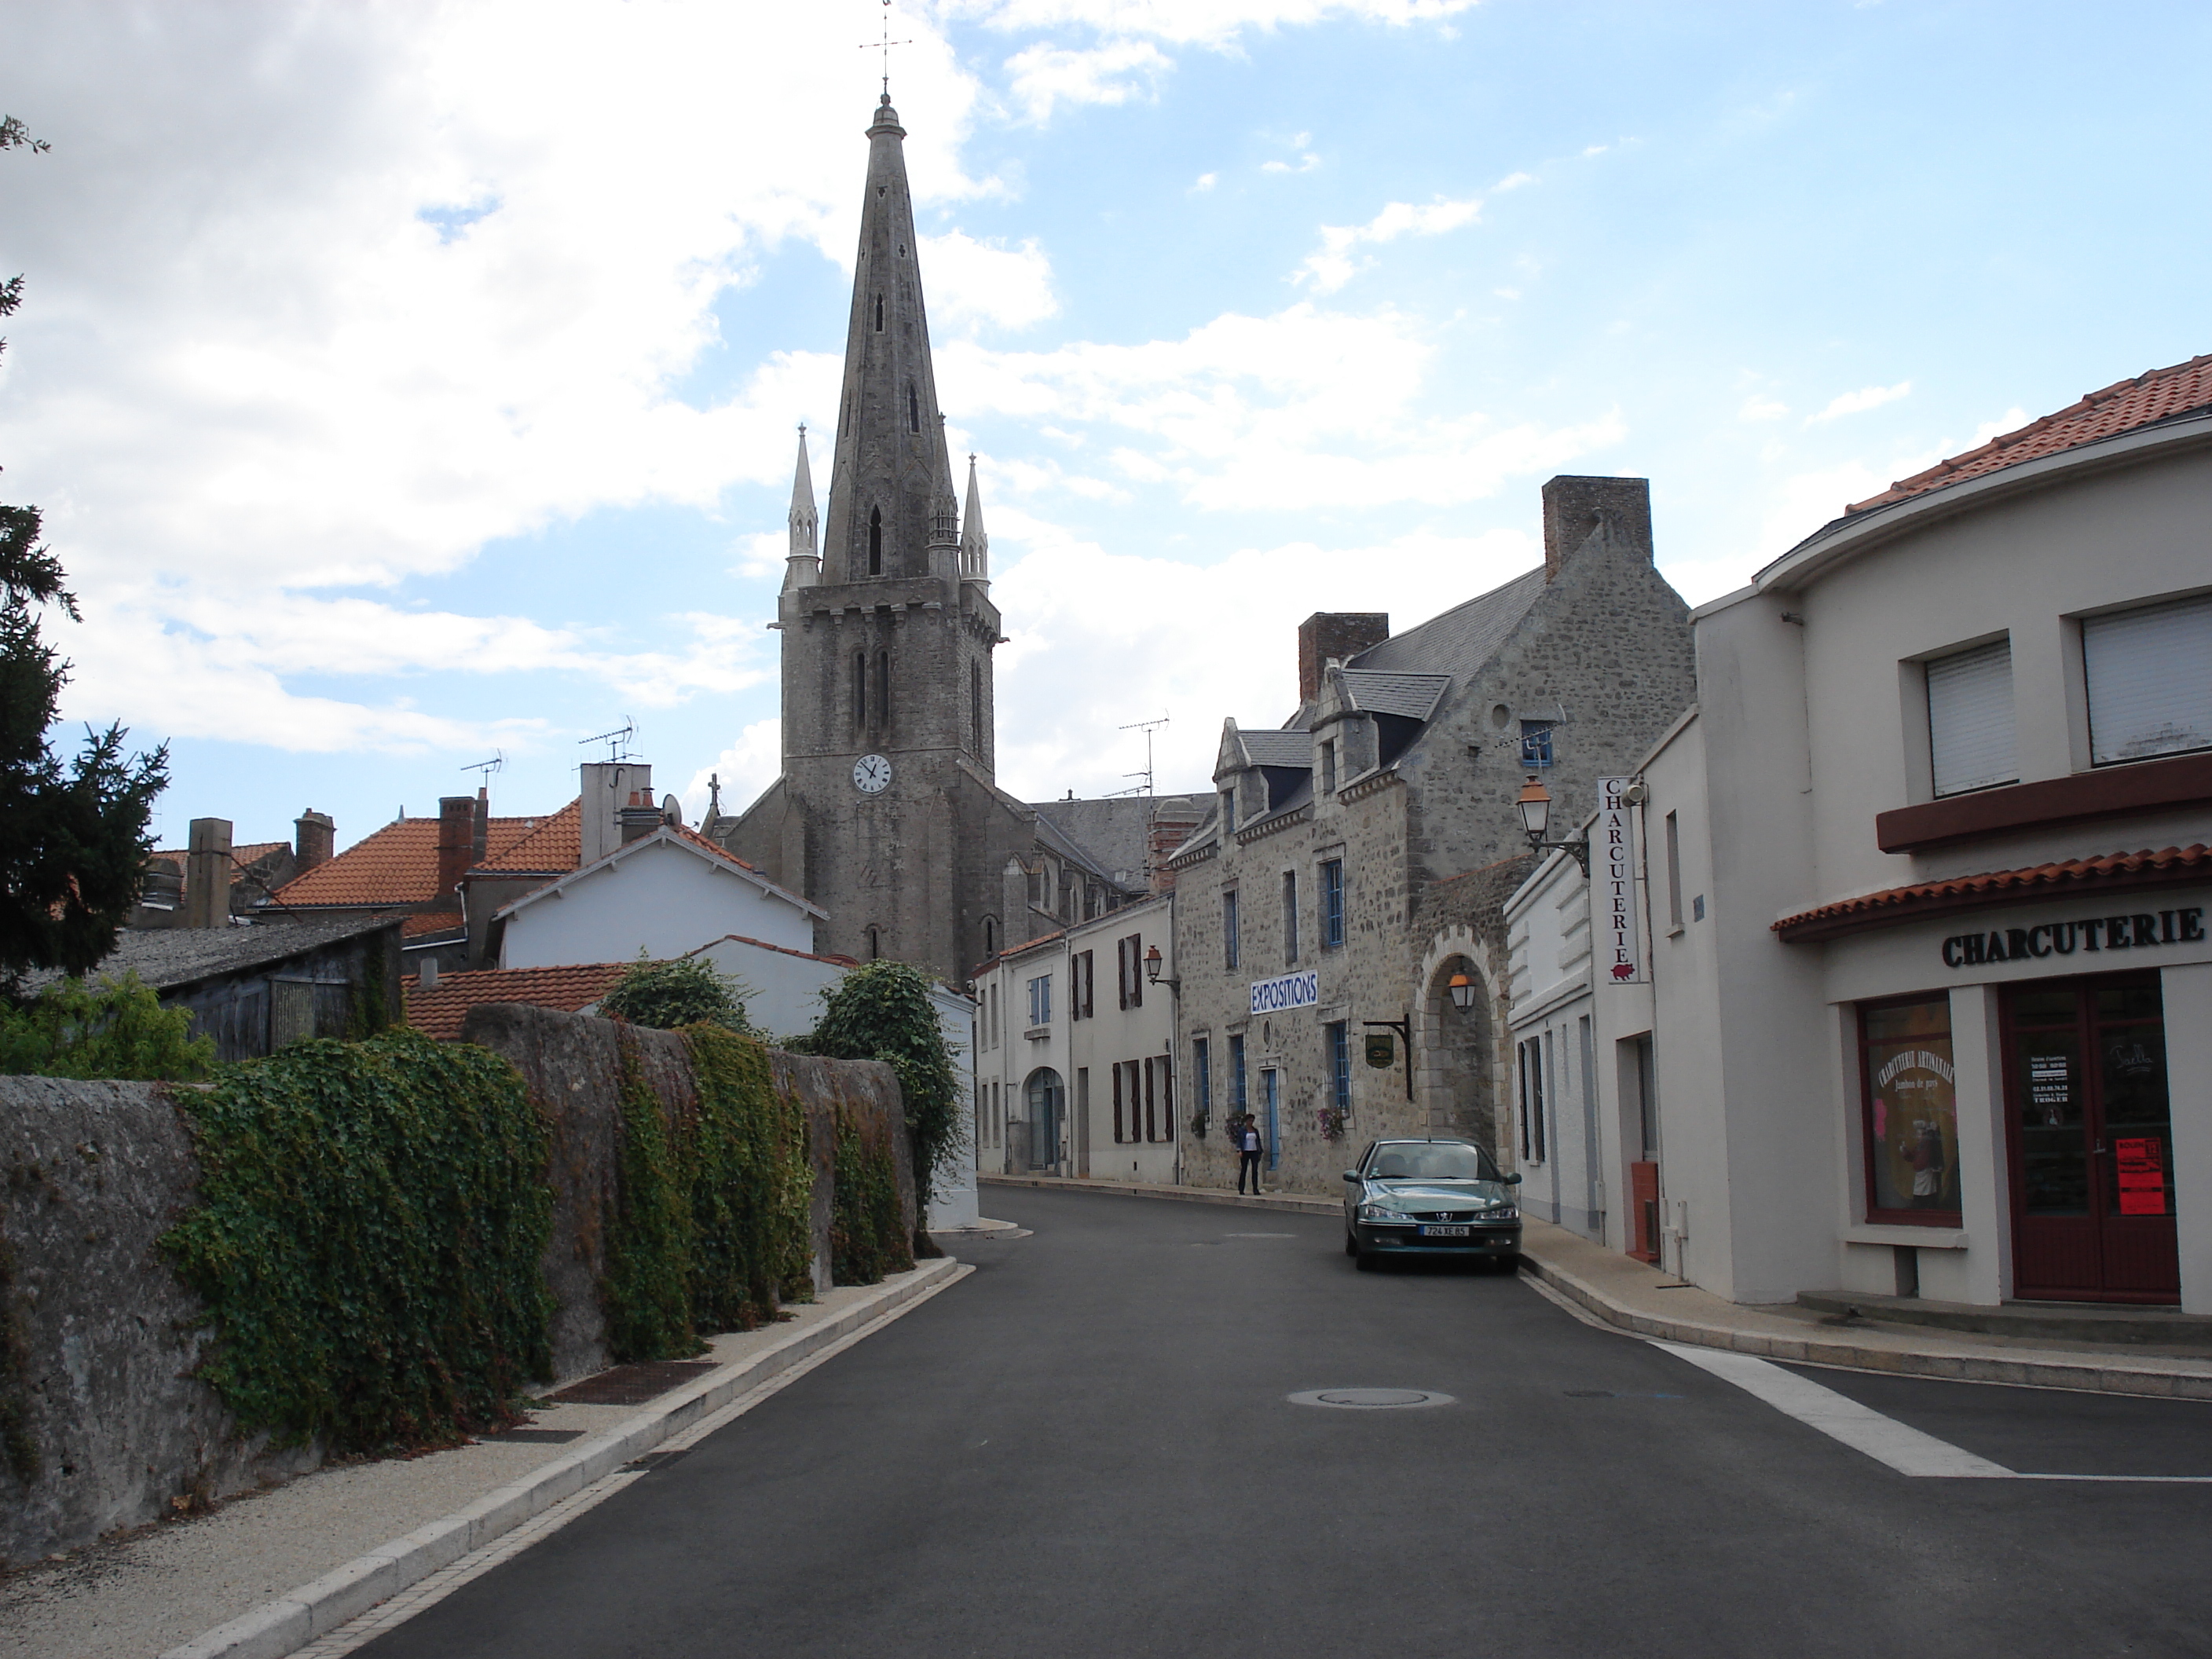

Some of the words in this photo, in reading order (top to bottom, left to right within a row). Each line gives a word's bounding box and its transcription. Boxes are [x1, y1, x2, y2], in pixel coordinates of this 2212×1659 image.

[1605, 779, 1628, 963] CHARCUTERIE
[1941, 906, 2206, 968] CHARCUTERIE
[1252, 974, 1316, 1011] EXPOSITIONS
[1878, 1050, 1915, 1088] CHARCUTERIE
[1895, 1079, 1915, 1092] Jambon
[1917, 1078, 1923, 1088] de
